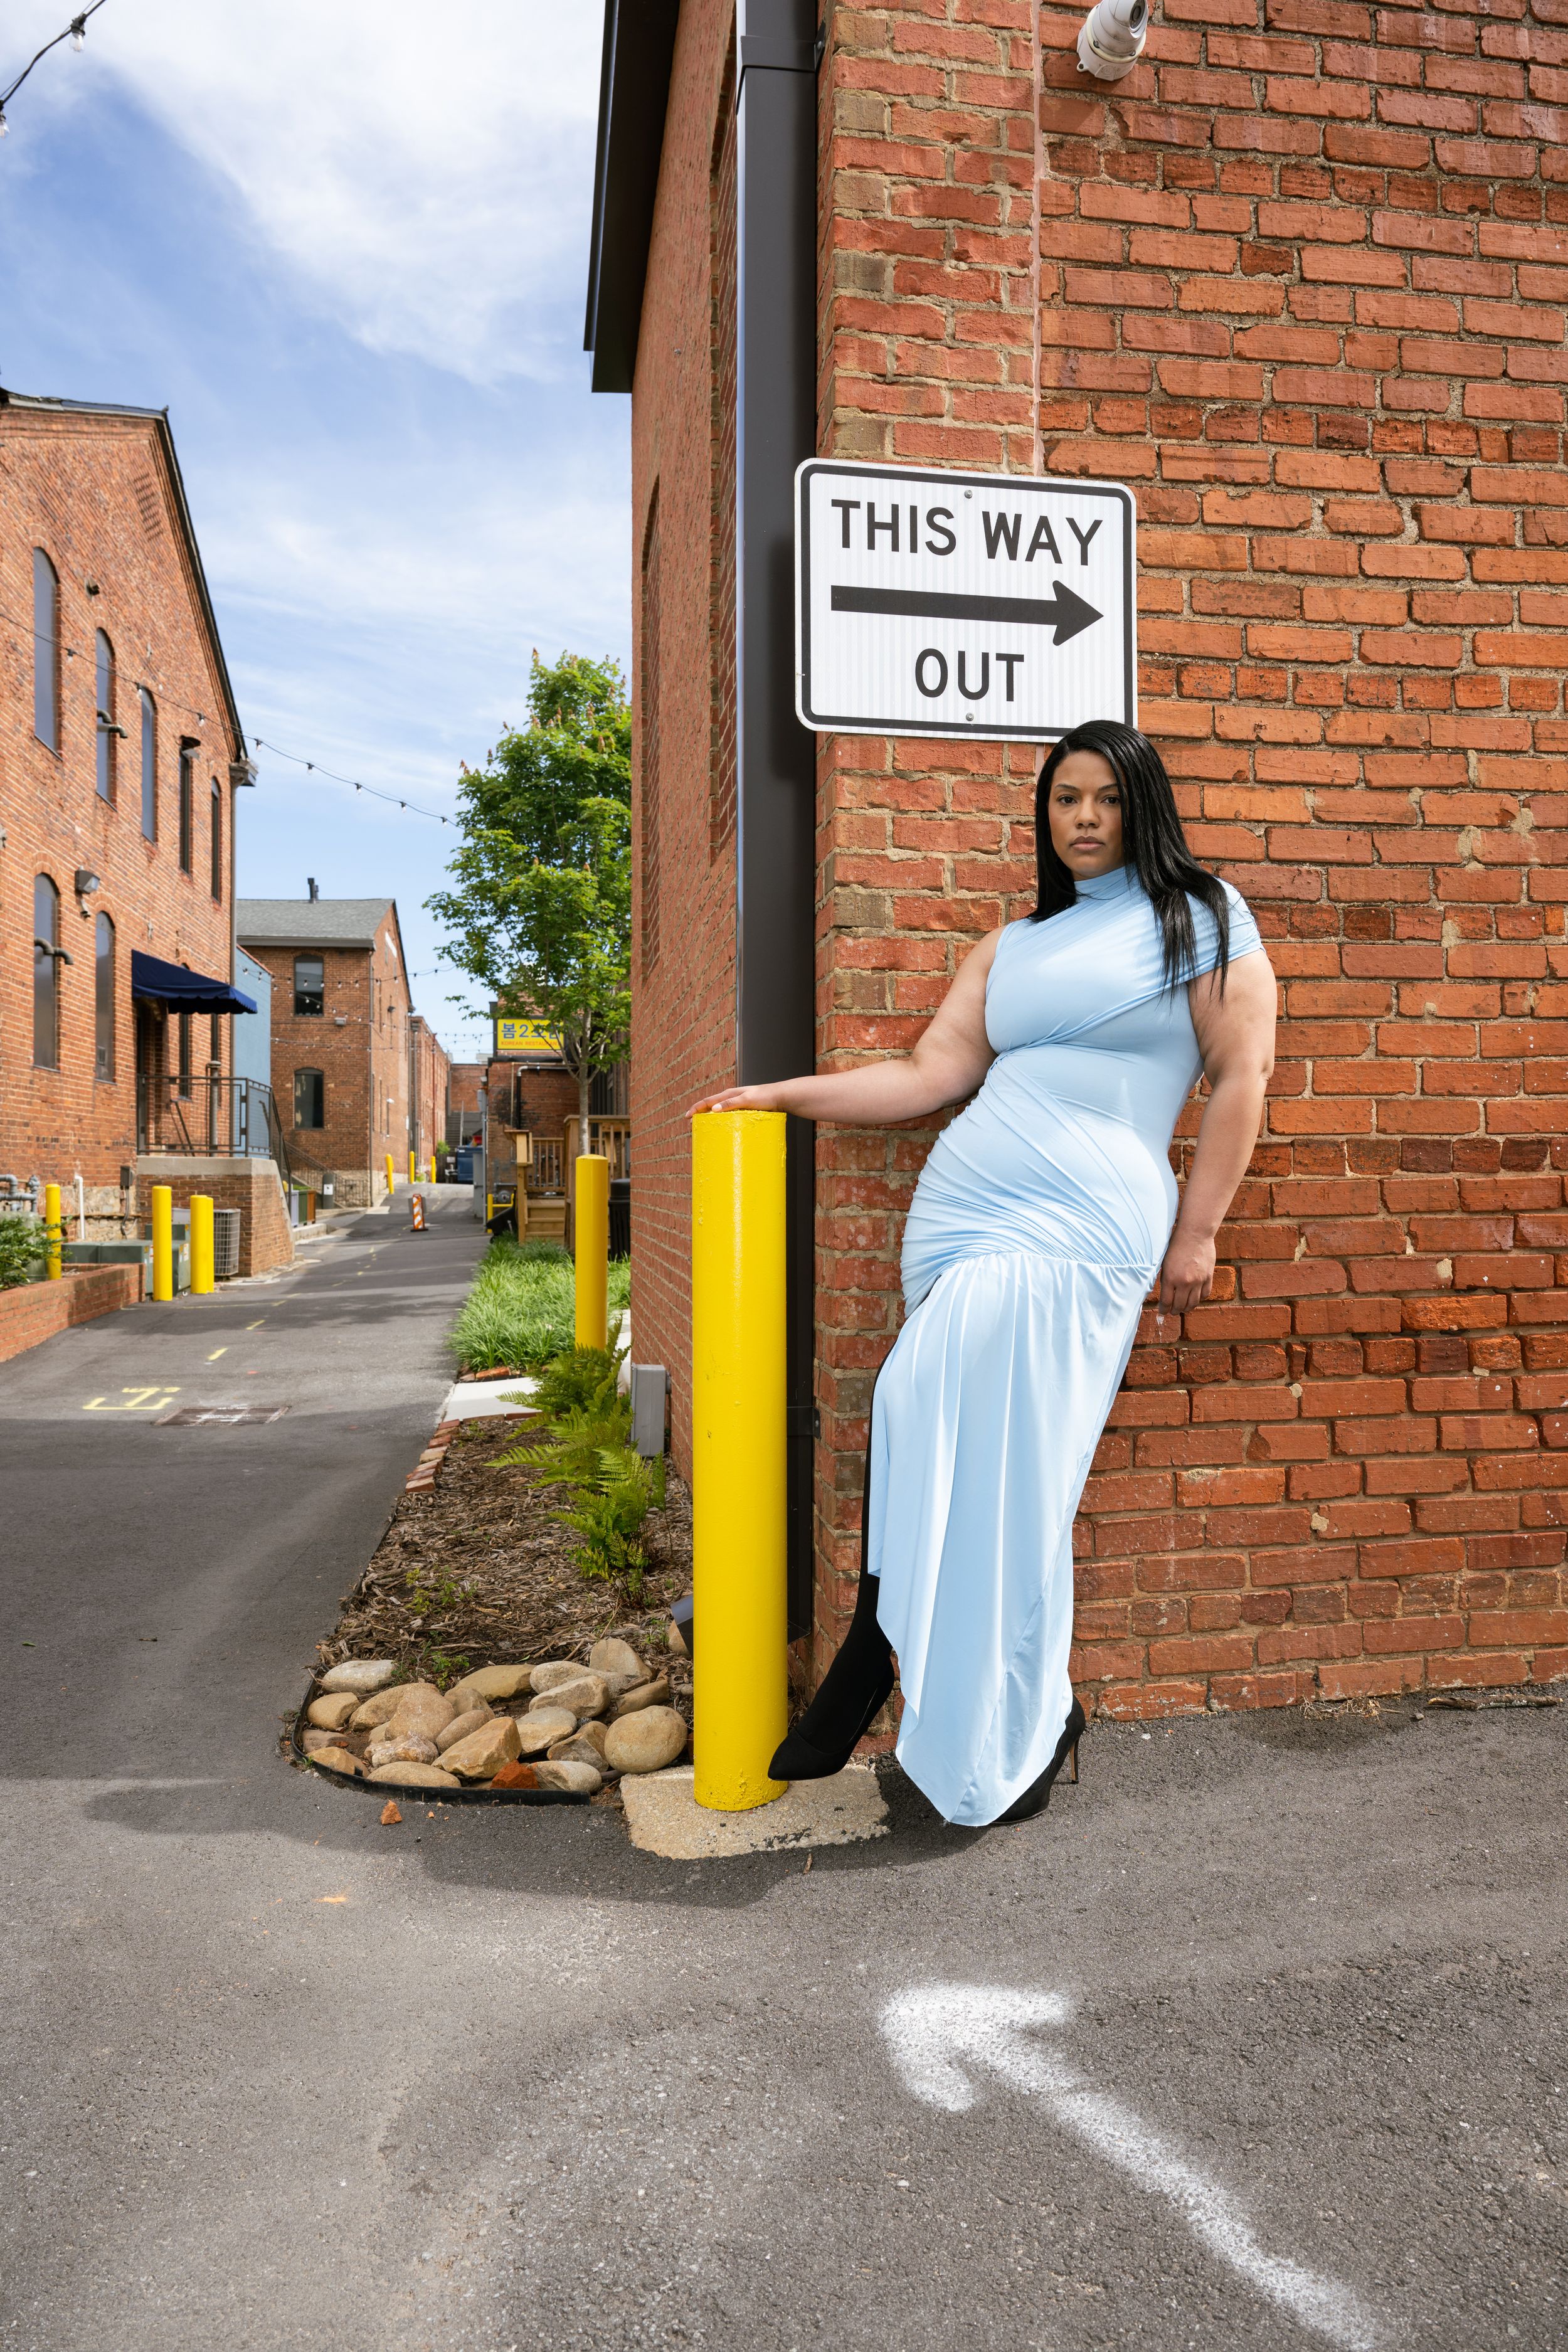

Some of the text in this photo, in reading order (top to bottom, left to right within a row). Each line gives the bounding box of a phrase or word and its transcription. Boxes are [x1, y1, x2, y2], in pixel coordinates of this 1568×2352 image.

[831, 499, 1103, 566] THIS WAY
[915, 649, 1024, 702] OUT
